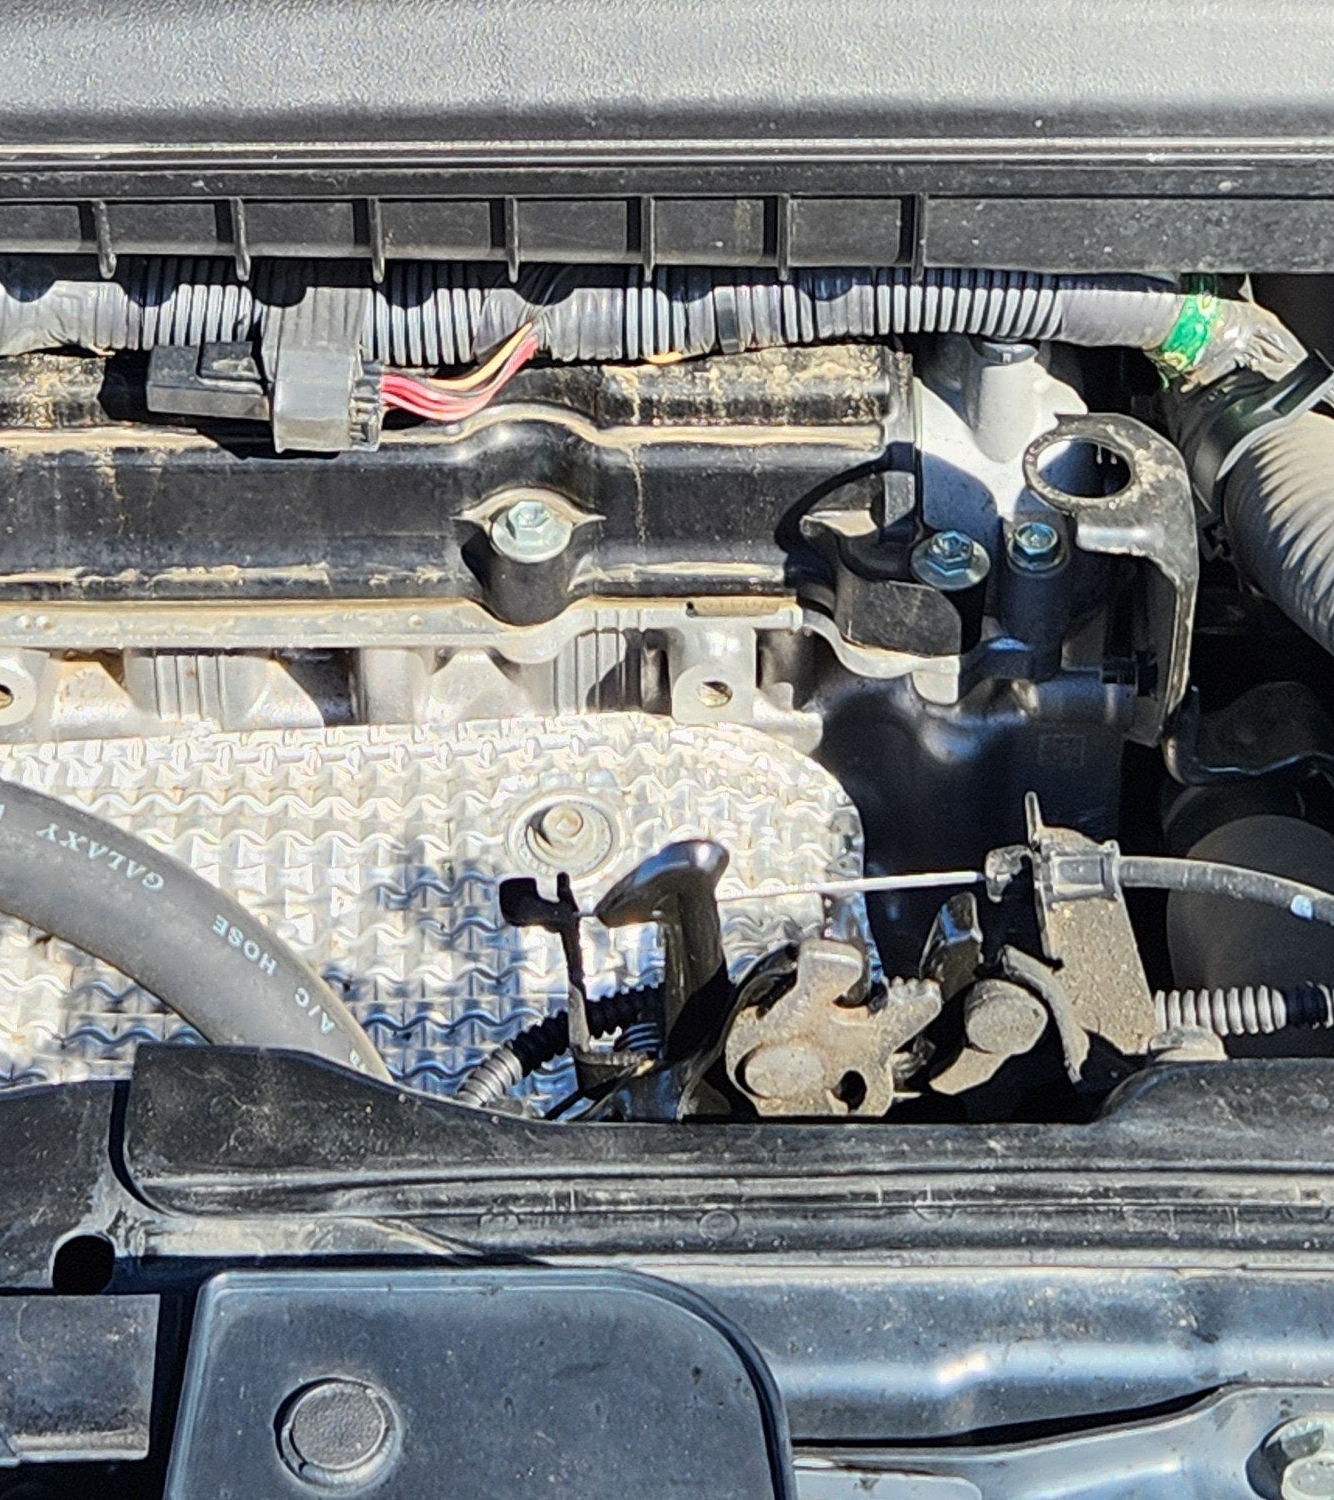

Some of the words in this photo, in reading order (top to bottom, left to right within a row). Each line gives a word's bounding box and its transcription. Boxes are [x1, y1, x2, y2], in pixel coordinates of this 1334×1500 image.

[35, 820, 165, 892] GALAXY
[210, 912, 278, 979] HOSE
[292, 986, 336, 1035] A/C
